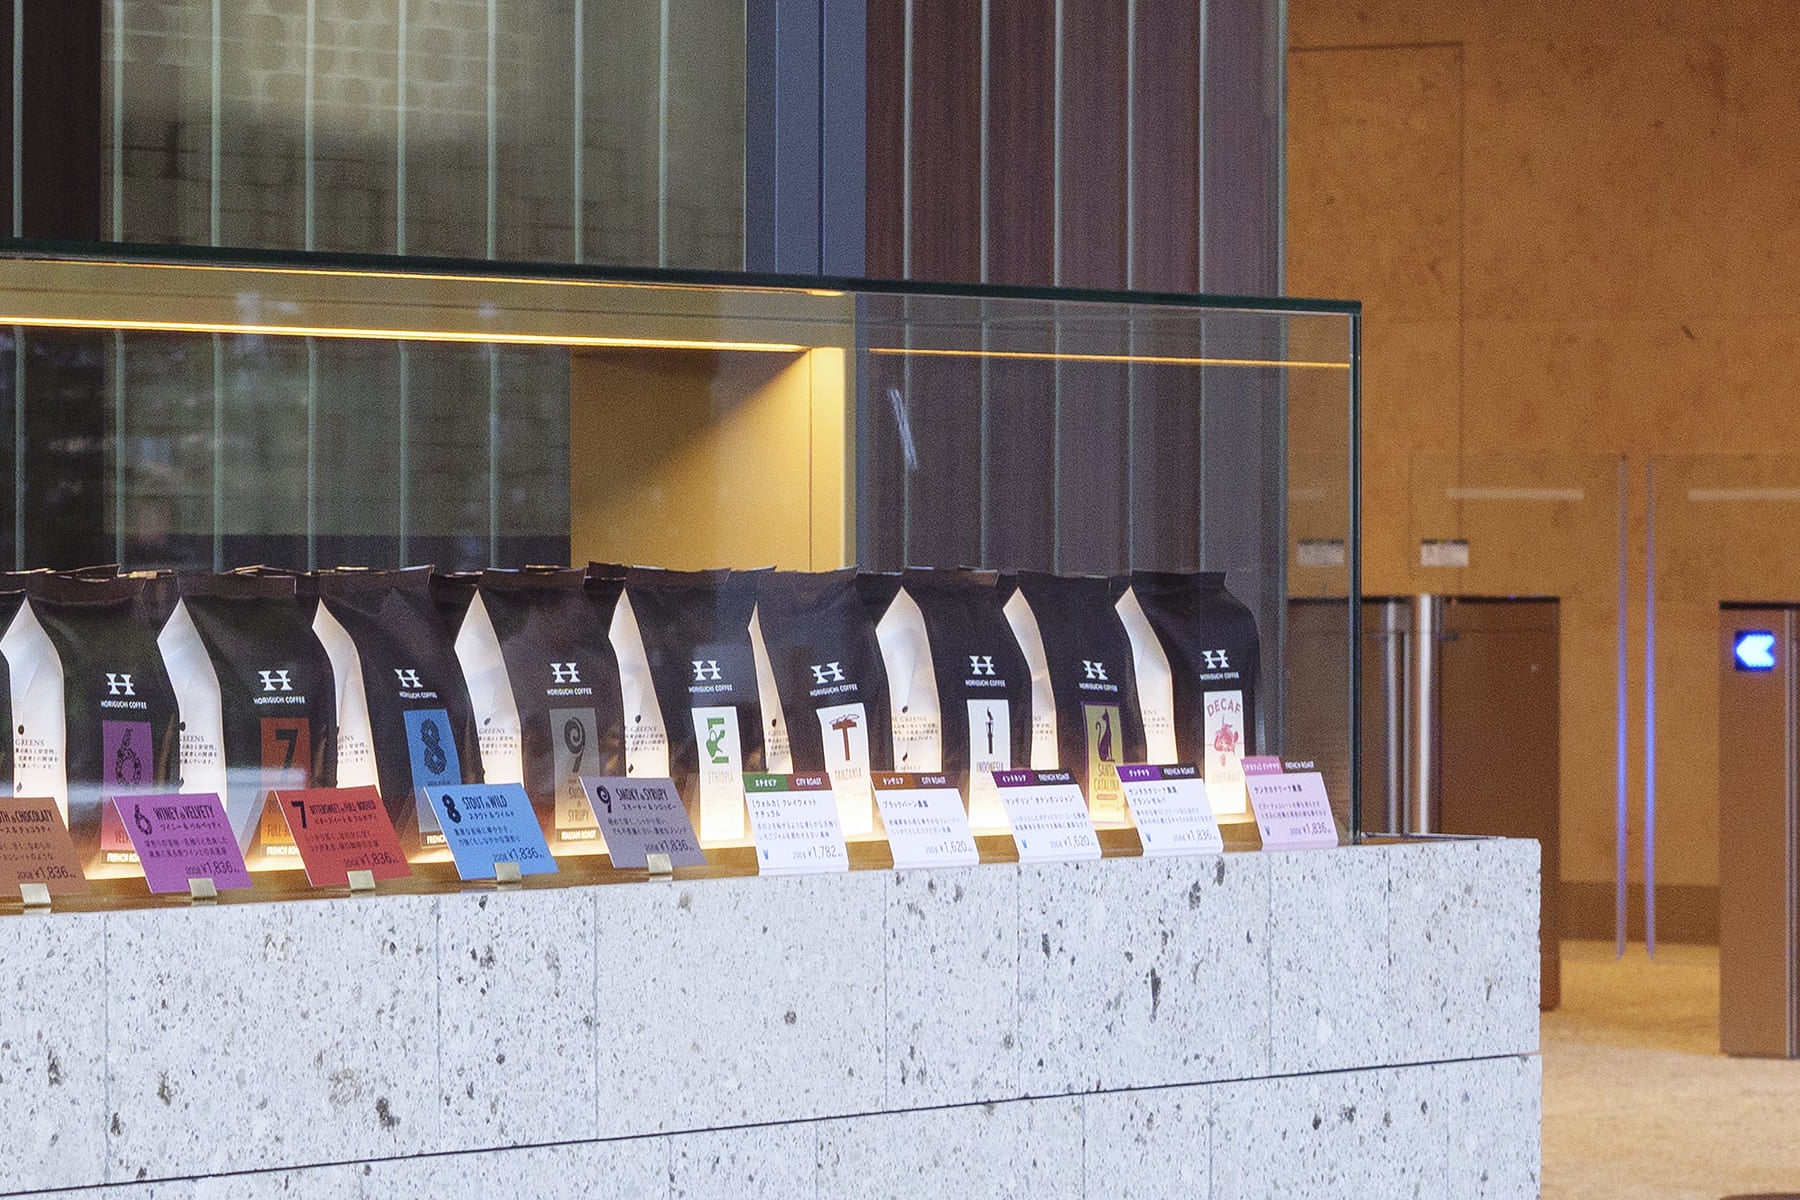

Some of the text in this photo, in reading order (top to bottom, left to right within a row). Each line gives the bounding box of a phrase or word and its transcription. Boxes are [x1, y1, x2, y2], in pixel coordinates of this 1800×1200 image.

[101, 701, 147, 710] HORIGUCHI COFFEE
[1207, 698, 1241, 716] DECAF
[275, 729, 298, 772] 7
[420, 719, 447, 775] 8
[564, 717, 586, 773] 9
[461, 795, 508, 810] STOUT WILD
[596, 785, 612, 814] 9
[15, 810, 54, 824] CHOCOLATY
[153, 804, 215, 821] WINEY VELVETY
[291, 800, 307, 829] 7
[442, 794, 462, 824] 8
[134, 803, 152, 836] 6
[1303, 822, 1327, 835] ¥1,836
[940, 841, 968, 854] ¥1,620
[1064, 835, 1090, 847] ¥1,620
[808, 845, 837, 860] ¥1,782
[35, 865, 69, 880] ¥1,836
